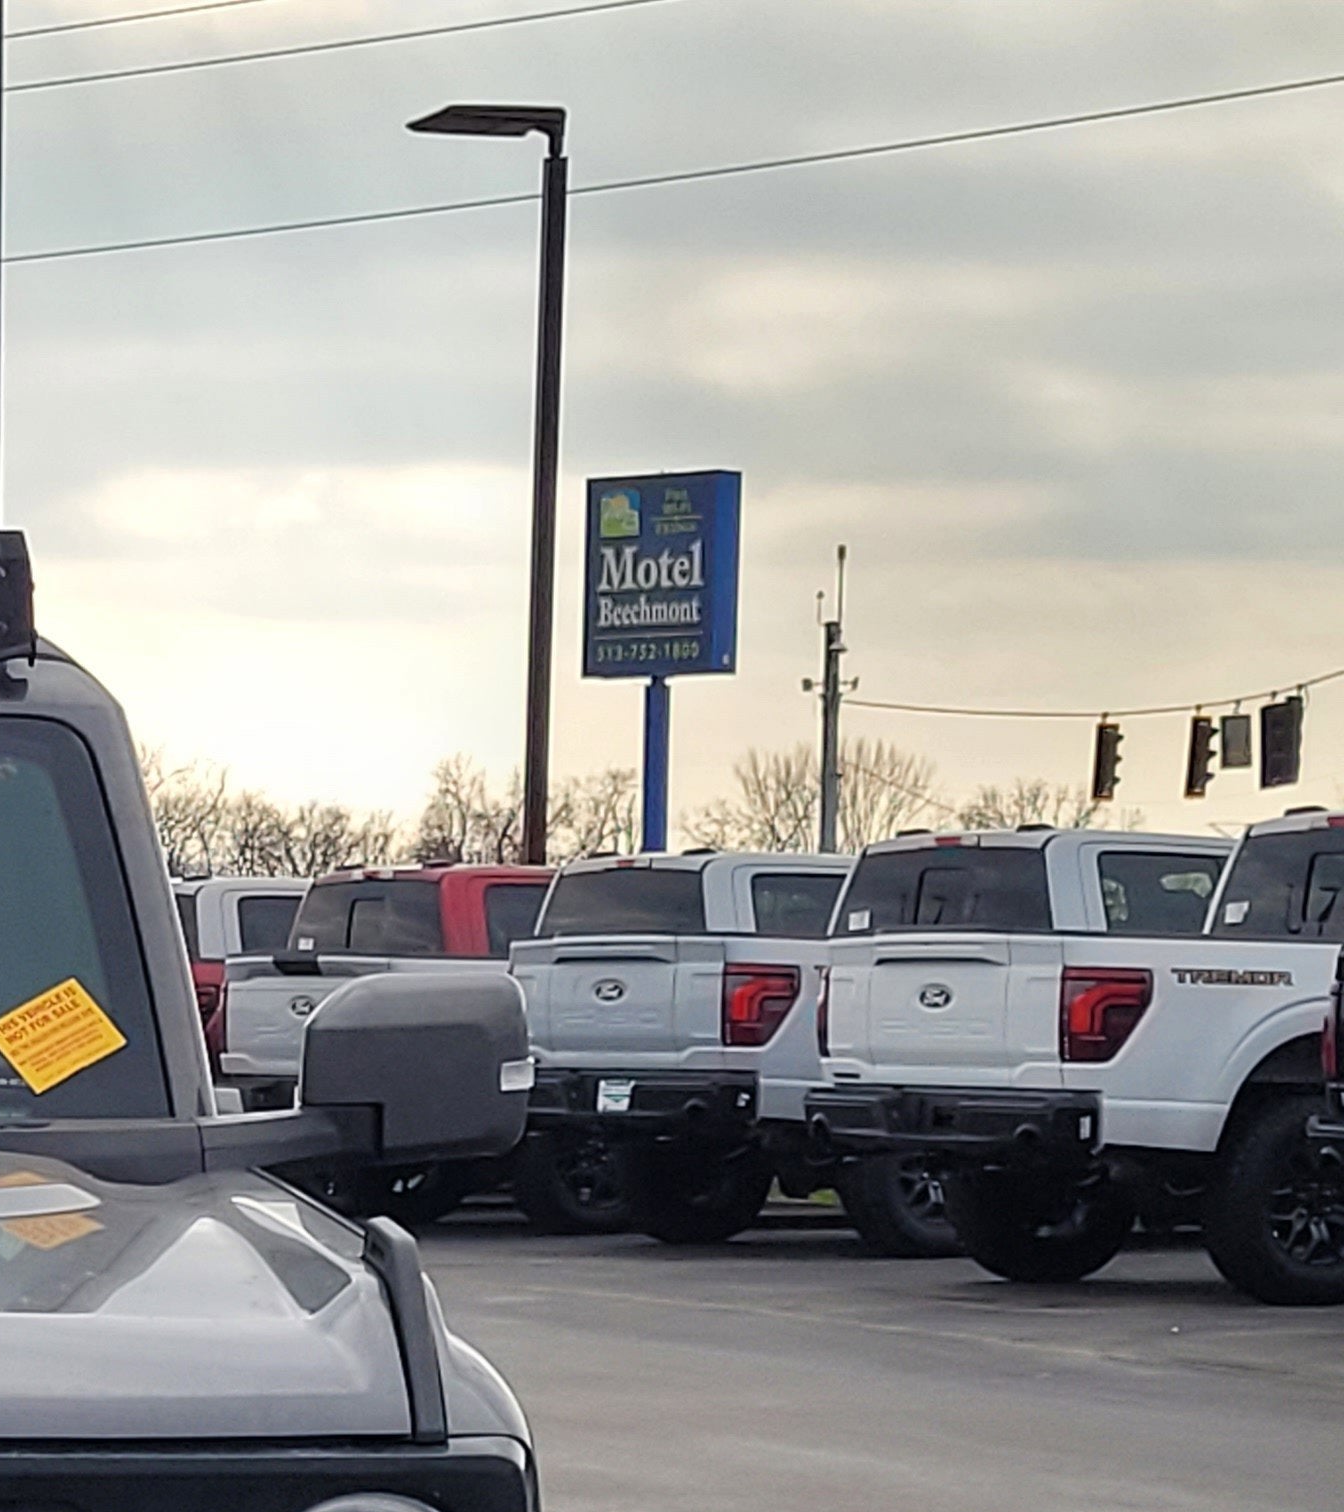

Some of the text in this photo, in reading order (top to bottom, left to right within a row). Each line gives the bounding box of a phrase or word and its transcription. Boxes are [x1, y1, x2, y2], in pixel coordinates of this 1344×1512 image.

[598, 540, 705, 592] Motel
[598, 594, 701, 628] Beechmont
[1171, 968, 1294, 986] TREMOR
[5, 999, 80, 1045] NOT FOR SALE
[20, 991, 65, 1022] VEHICLE
[64, 986, 77, 999] IS
